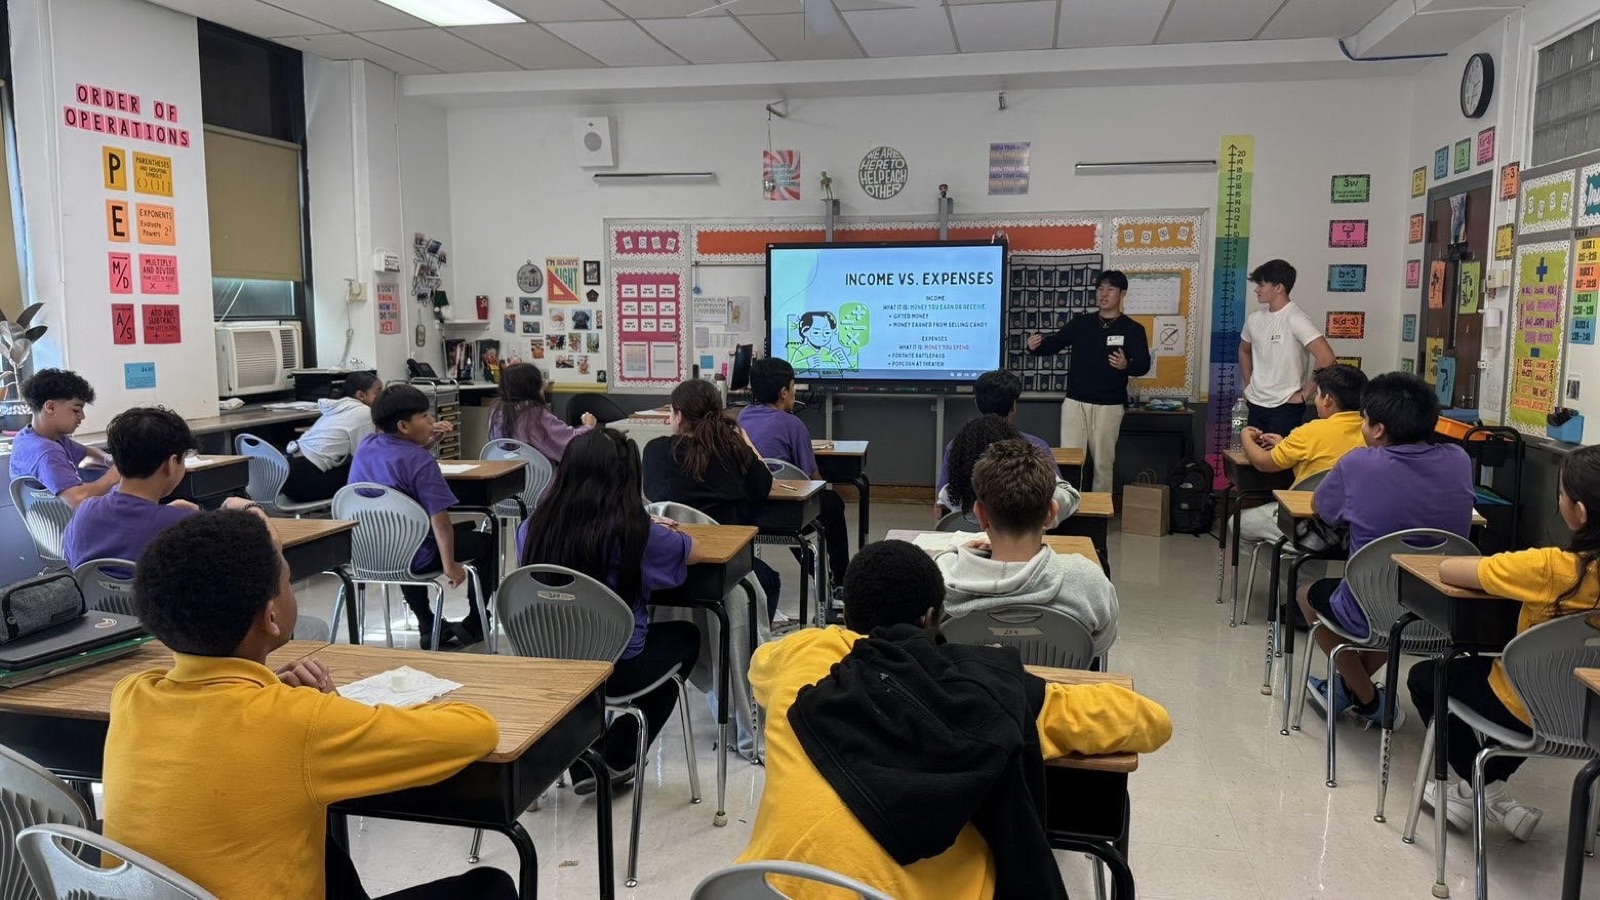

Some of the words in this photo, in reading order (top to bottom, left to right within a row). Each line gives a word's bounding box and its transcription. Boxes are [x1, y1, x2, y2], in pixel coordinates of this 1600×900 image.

[77, 85, 140, 113] ORDER
[154, 102, 177, 121] OF
[65, 108, 189, 146] OPERATIONS
[868, 149, 881, 159] WE
[880, 147, 902, 159] ARE
[1237, 150, 1246, 158] 20
[108, 152, 121, 184] P
[135, 157, 170, 169] PARENTHESES
[861, 159, 889, 170] HERE
[889, 159, 905, 169] TO
[860, 170, 885, 185] HELP
[885, 169, 907, 183] EACH
[1343, 179, 1359, 187] 3w
[865, 184, 902, 198] OTHER
[139, 208, 173, 220] EXPONENTS
[111, 205, 125, 237] E
[145, 258, 172, 267] MULTIPLY
[143, 266, 154, 275] AND
[155, 267, 176, 276] DIVIDE
[1338, 269, 1357, 279] b+3
[555, 268, 578, 296] RIGHT
[845, 273, 894, 286] INCOME
[898, 273, 919, 286] VS.
[922, 271, 994, 286] EXPENSES
[150, 309, 162, 317] ADD
[163, 309, 174, 317] AND
[148, 316, 177, 325] SUBTRACT
